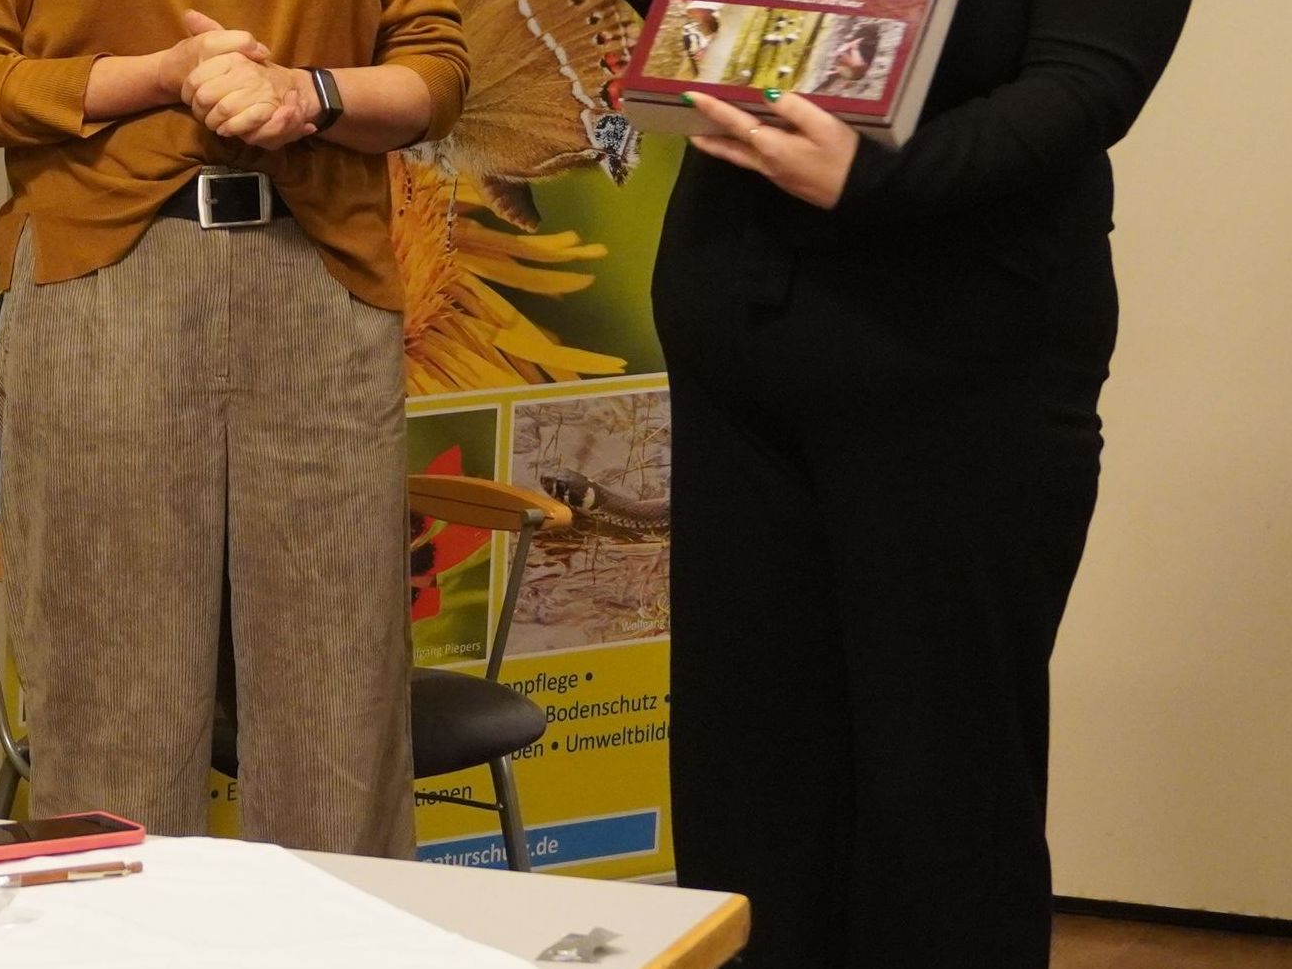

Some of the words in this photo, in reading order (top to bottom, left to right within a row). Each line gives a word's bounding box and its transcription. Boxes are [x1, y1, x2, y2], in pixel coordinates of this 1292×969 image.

[445, 641, 481, 655] Piepers
[546, 693, 658, 723] Bodenschutz
[566, 724, 670, 752] Umweltbild
